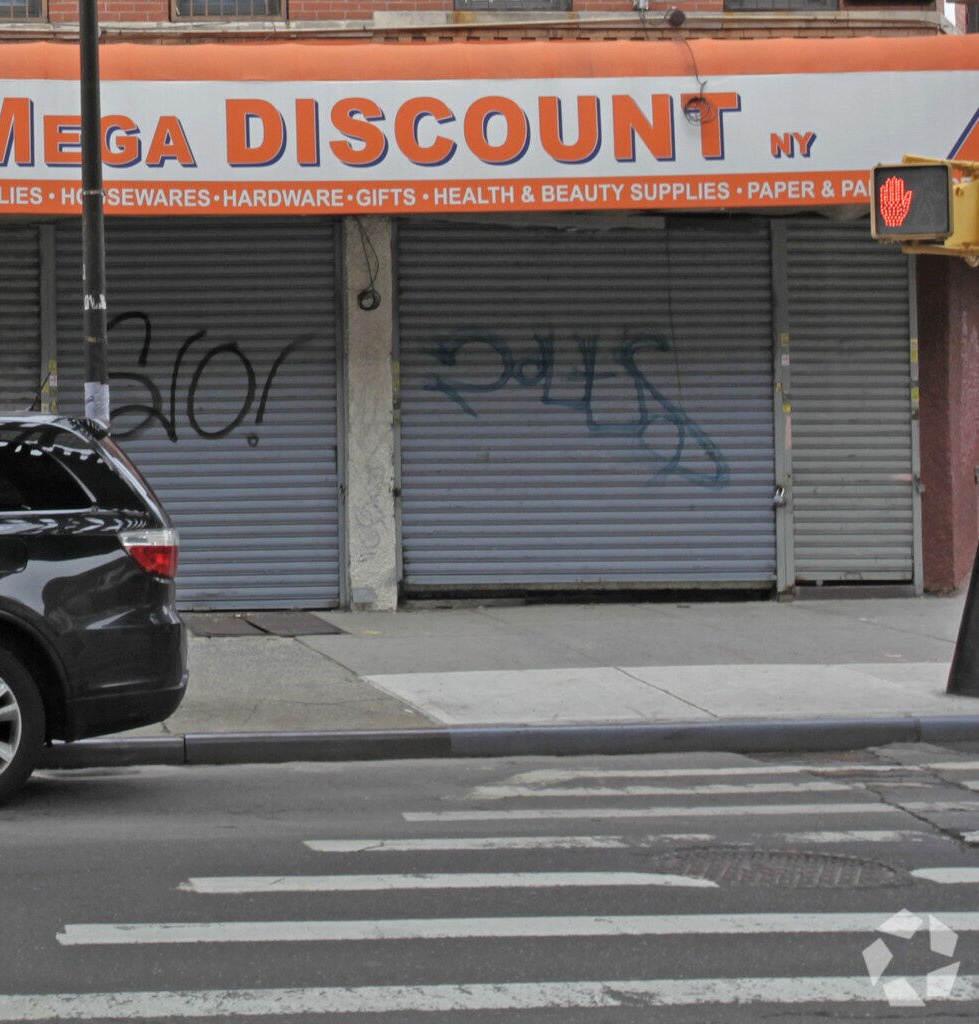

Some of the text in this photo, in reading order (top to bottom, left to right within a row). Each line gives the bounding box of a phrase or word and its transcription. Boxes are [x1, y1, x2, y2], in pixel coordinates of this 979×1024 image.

[225, 91, 741, 168] DISCOUNT
[770, 131, 817, 158] NY
[60, 187, 211, 207] HSEWARES
[223, 188, 344, 207] HARDWARE
[356, 187, 416, 207] GIFTS
[433, 186, 515, 206] HEALTH
[521, 184, 535, 203] &
[541, 183, 625, 203] BEAUTY
[630, 181, 731, 201] SUPPLIES
[747, 180, 815, 199] PAPER
[821, 180, 835, 198] &
